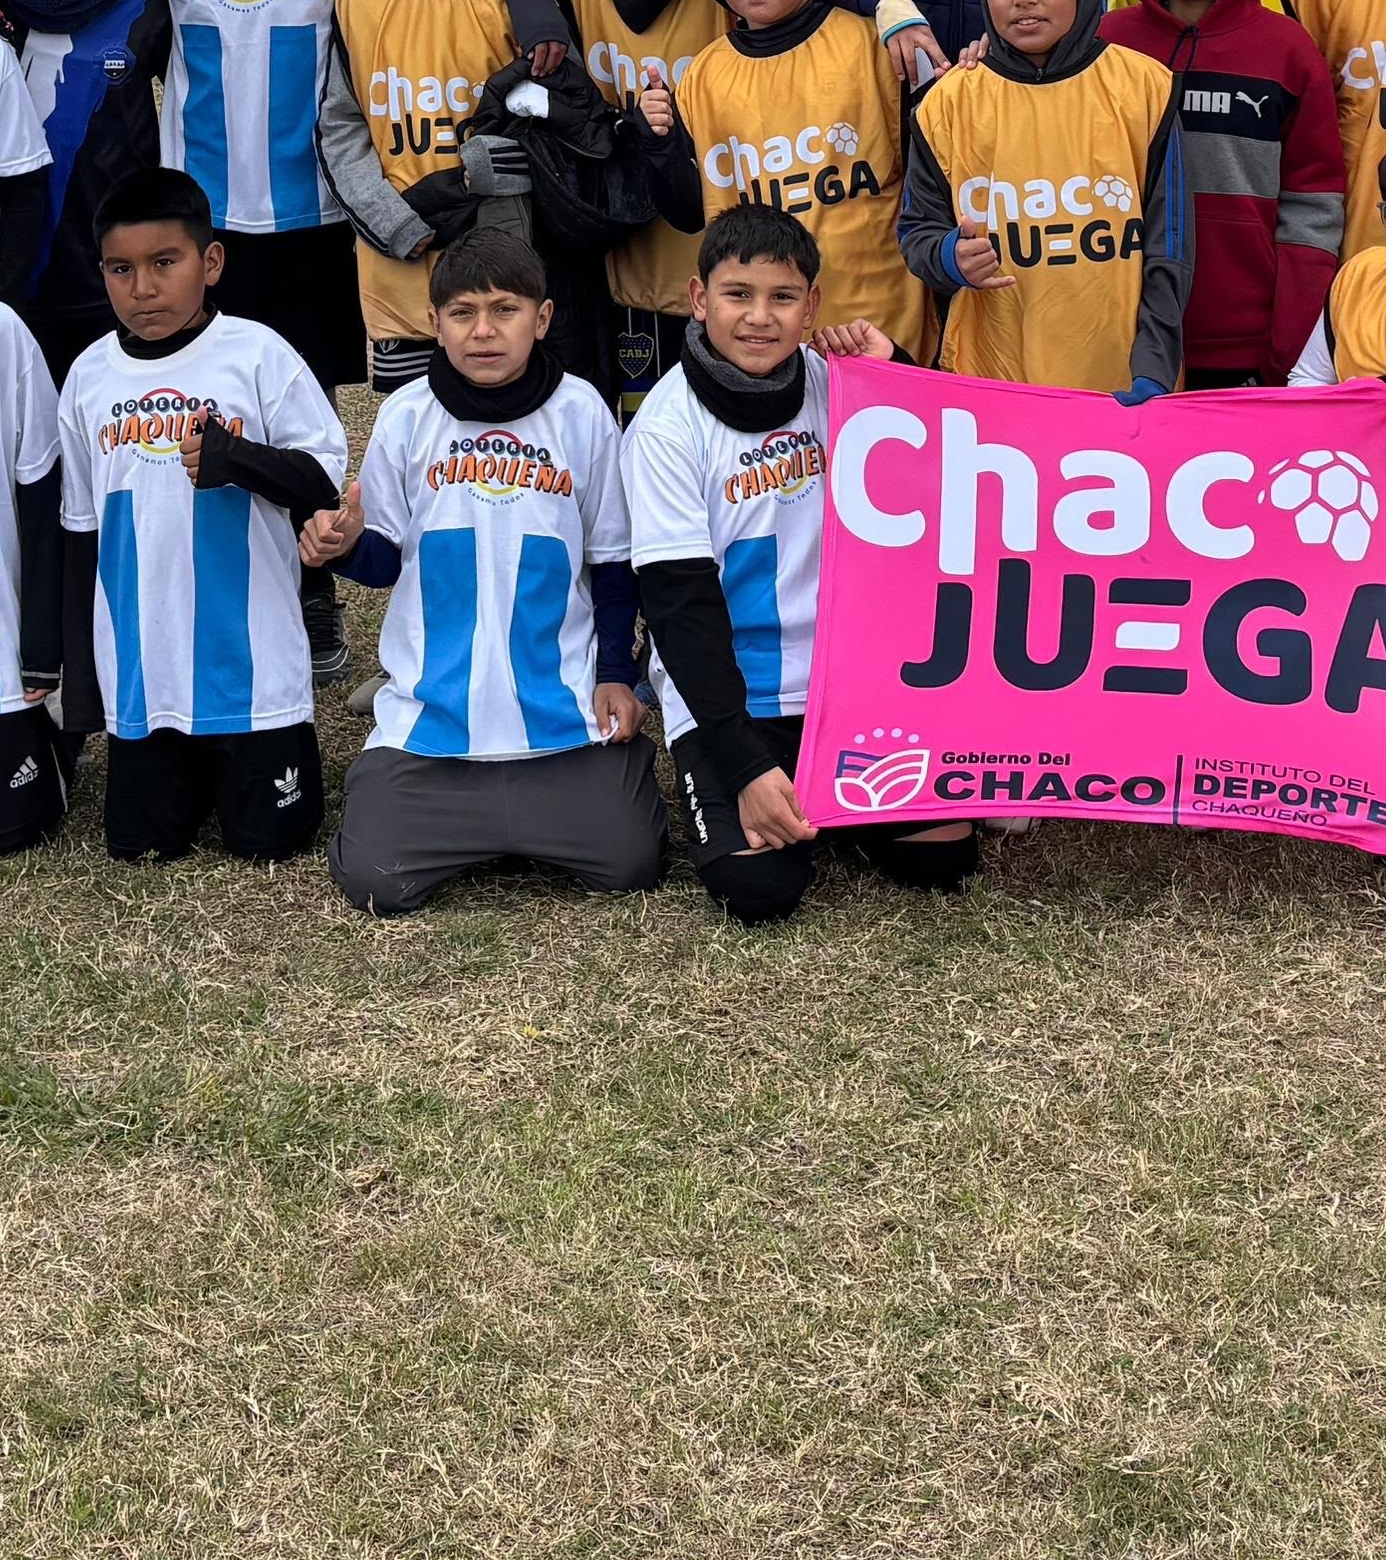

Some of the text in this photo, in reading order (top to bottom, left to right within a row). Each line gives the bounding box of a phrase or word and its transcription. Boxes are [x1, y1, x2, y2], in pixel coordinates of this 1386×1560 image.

[427, 453, 573, 498] CHAQUEÑA
[941, 750, 1071, 766] Gobierno Del
[933, 770, 1166, 806] CHACO
[1195, 757, 1376, 796] INSTITUTO DEL
[1192, 799, 1329, 827] CHAQUEÑO
